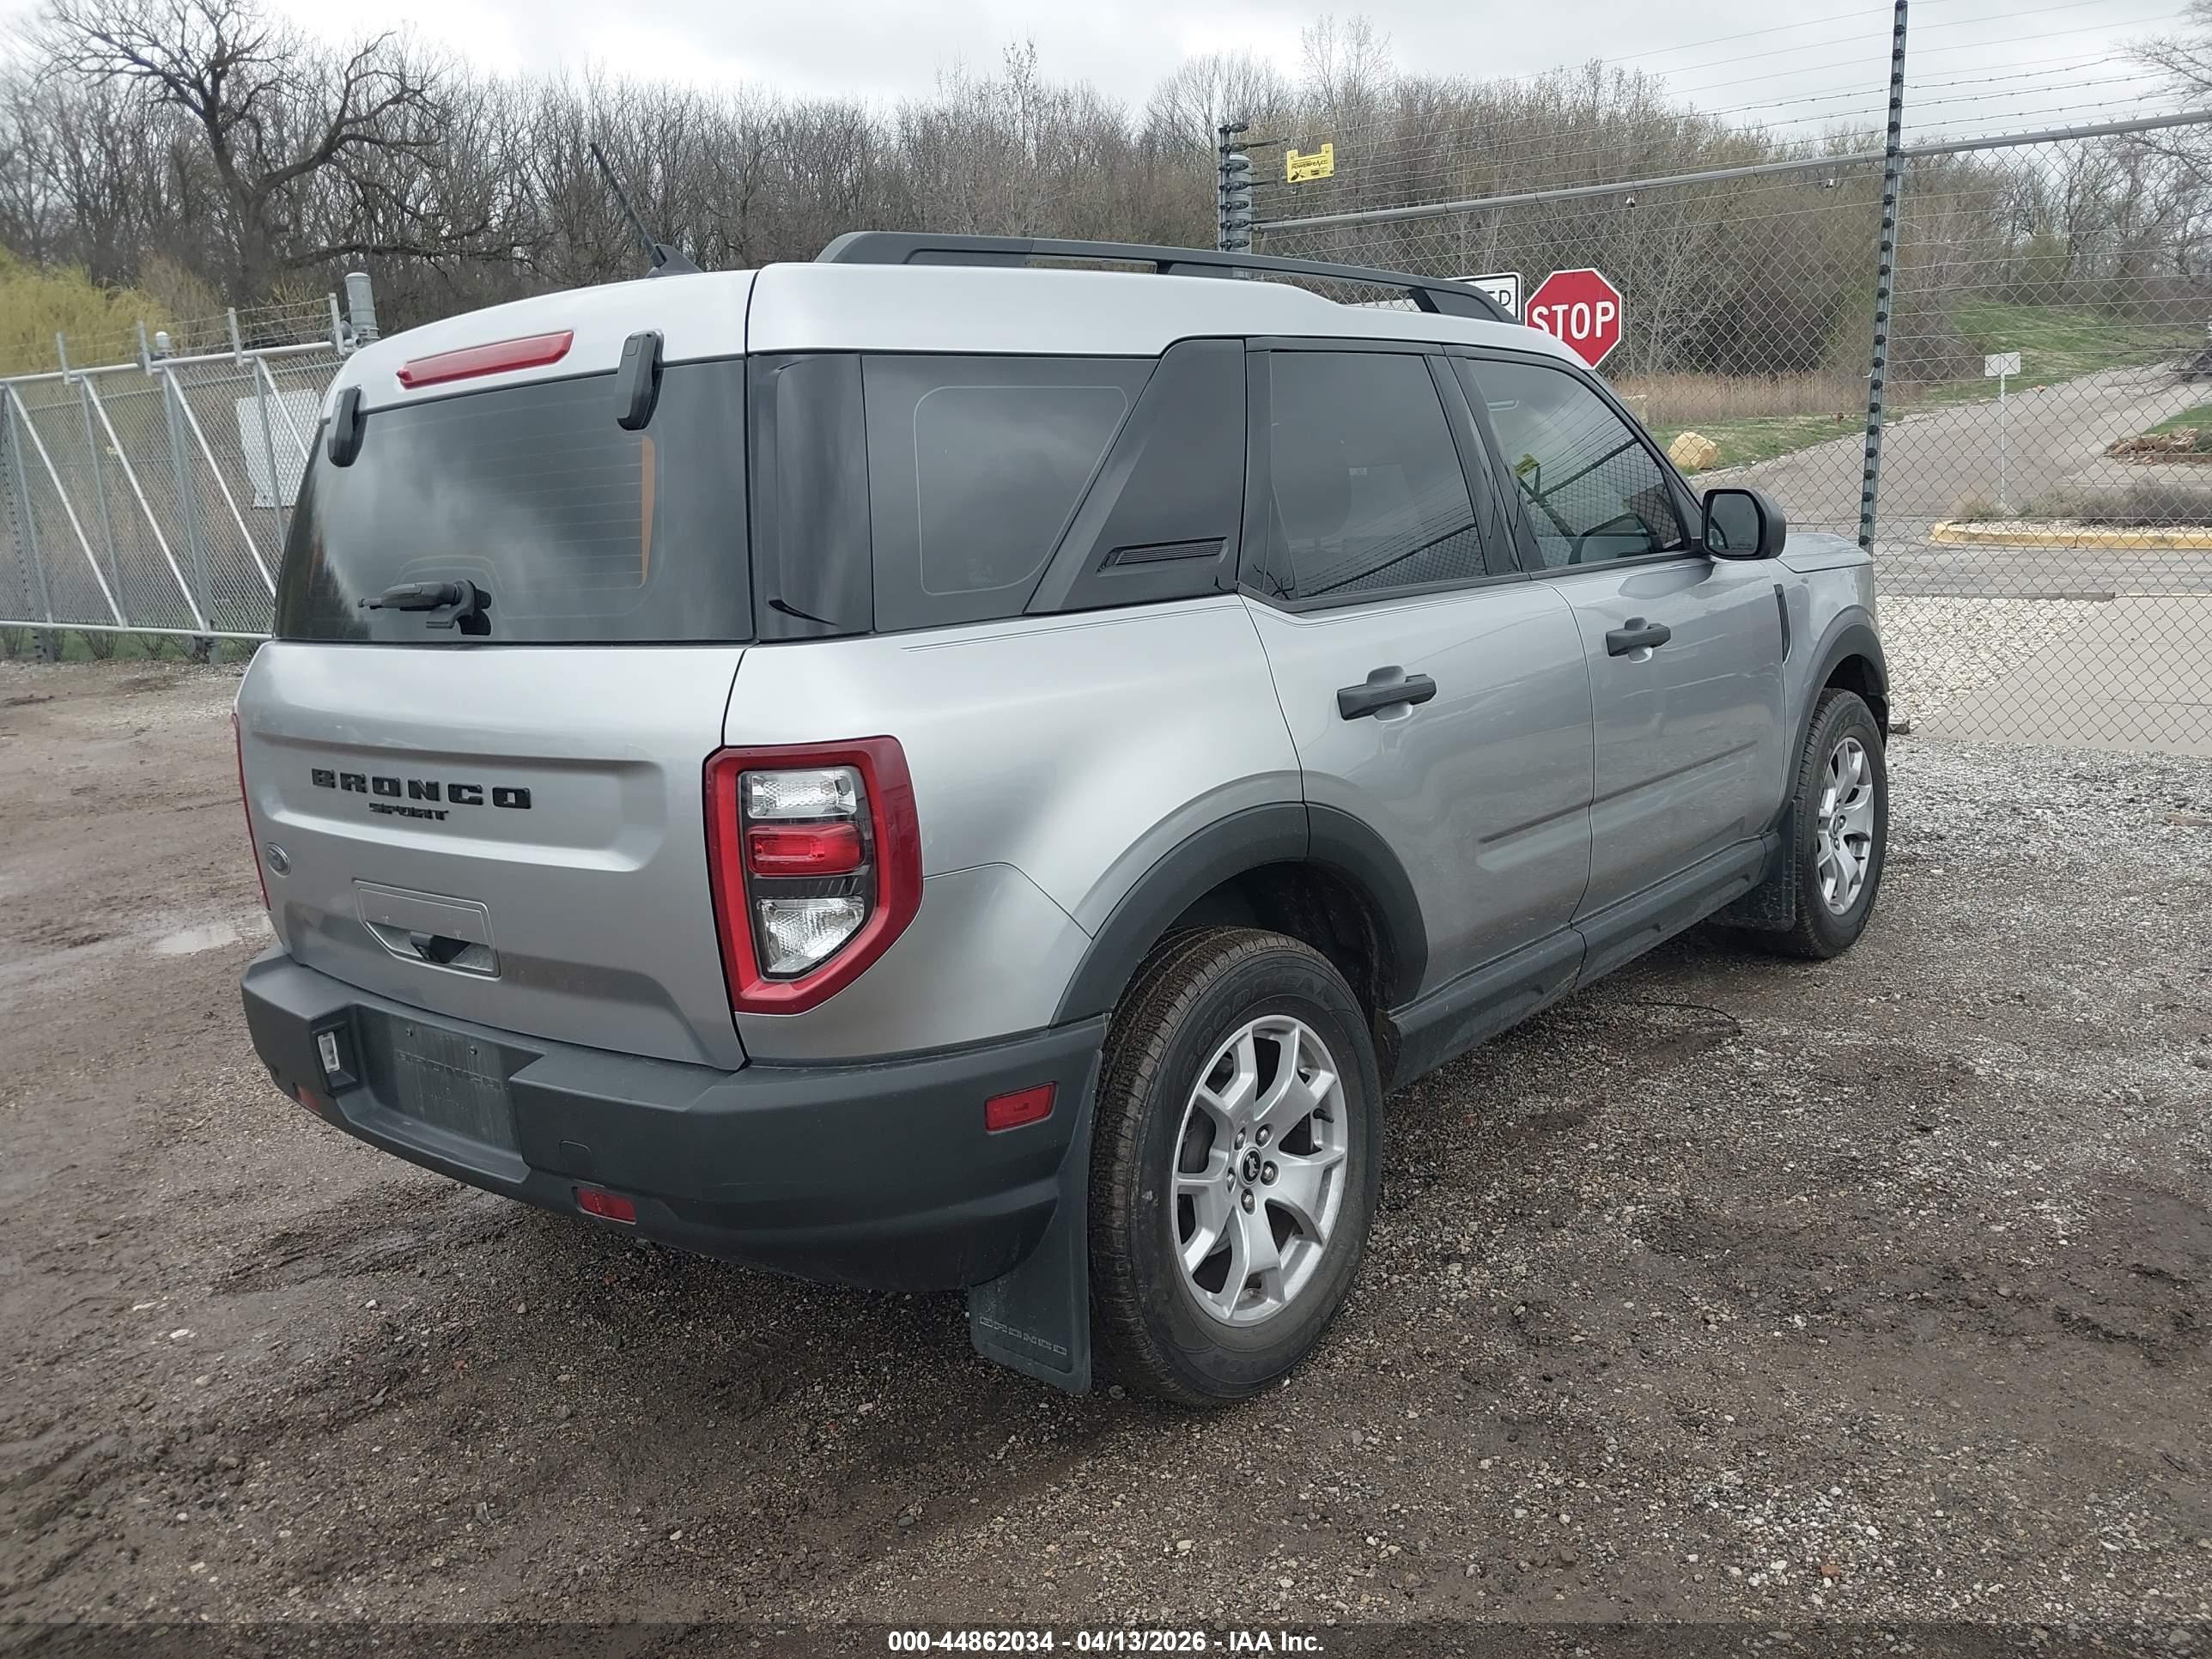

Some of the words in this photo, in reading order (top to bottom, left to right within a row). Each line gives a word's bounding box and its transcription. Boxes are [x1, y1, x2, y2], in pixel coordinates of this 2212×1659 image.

[1531, 301, 1616, 340] STOP
[311, 768, 532, 810] BRONCO
[368, 802, 449, 821] SPORT
